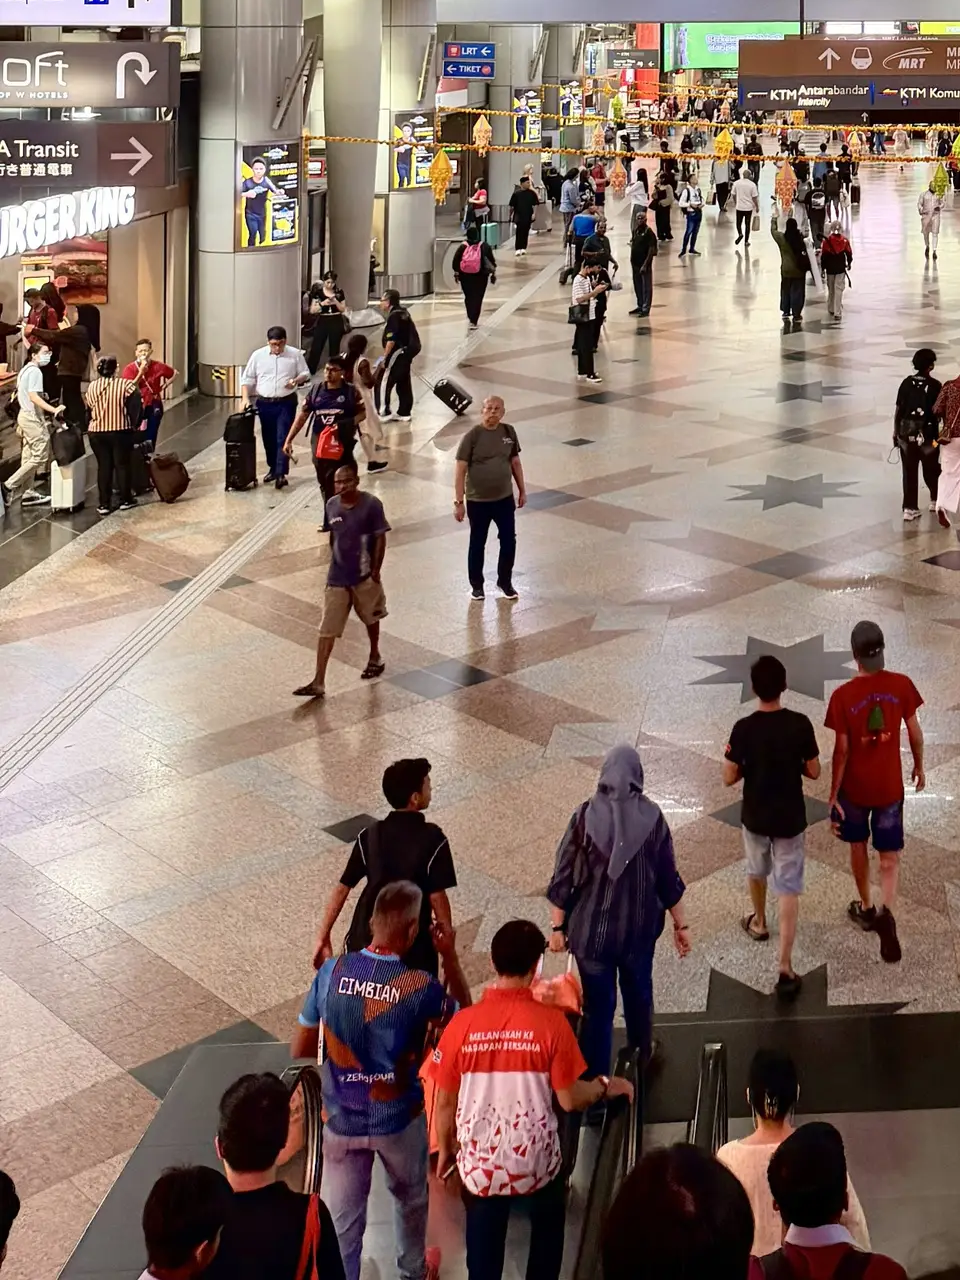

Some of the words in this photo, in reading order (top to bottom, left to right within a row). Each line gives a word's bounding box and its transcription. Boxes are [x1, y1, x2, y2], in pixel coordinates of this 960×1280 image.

[461, 47, 478, 55] LRT
[459, 65, 481, 73] TIKET
[898, 57, 926, 69] MRT
[770, 89, 797, 100] KTM
[798, 84, 869, 96] Antarabandar
[900, 87, 926, 98] KTM
[797, 97, 831, 108] Intercity
[14, 140, 79, 158] Transit
[72, 186, 135, 238] KING
[339, 976, 400, 1004] CIMBIAN
